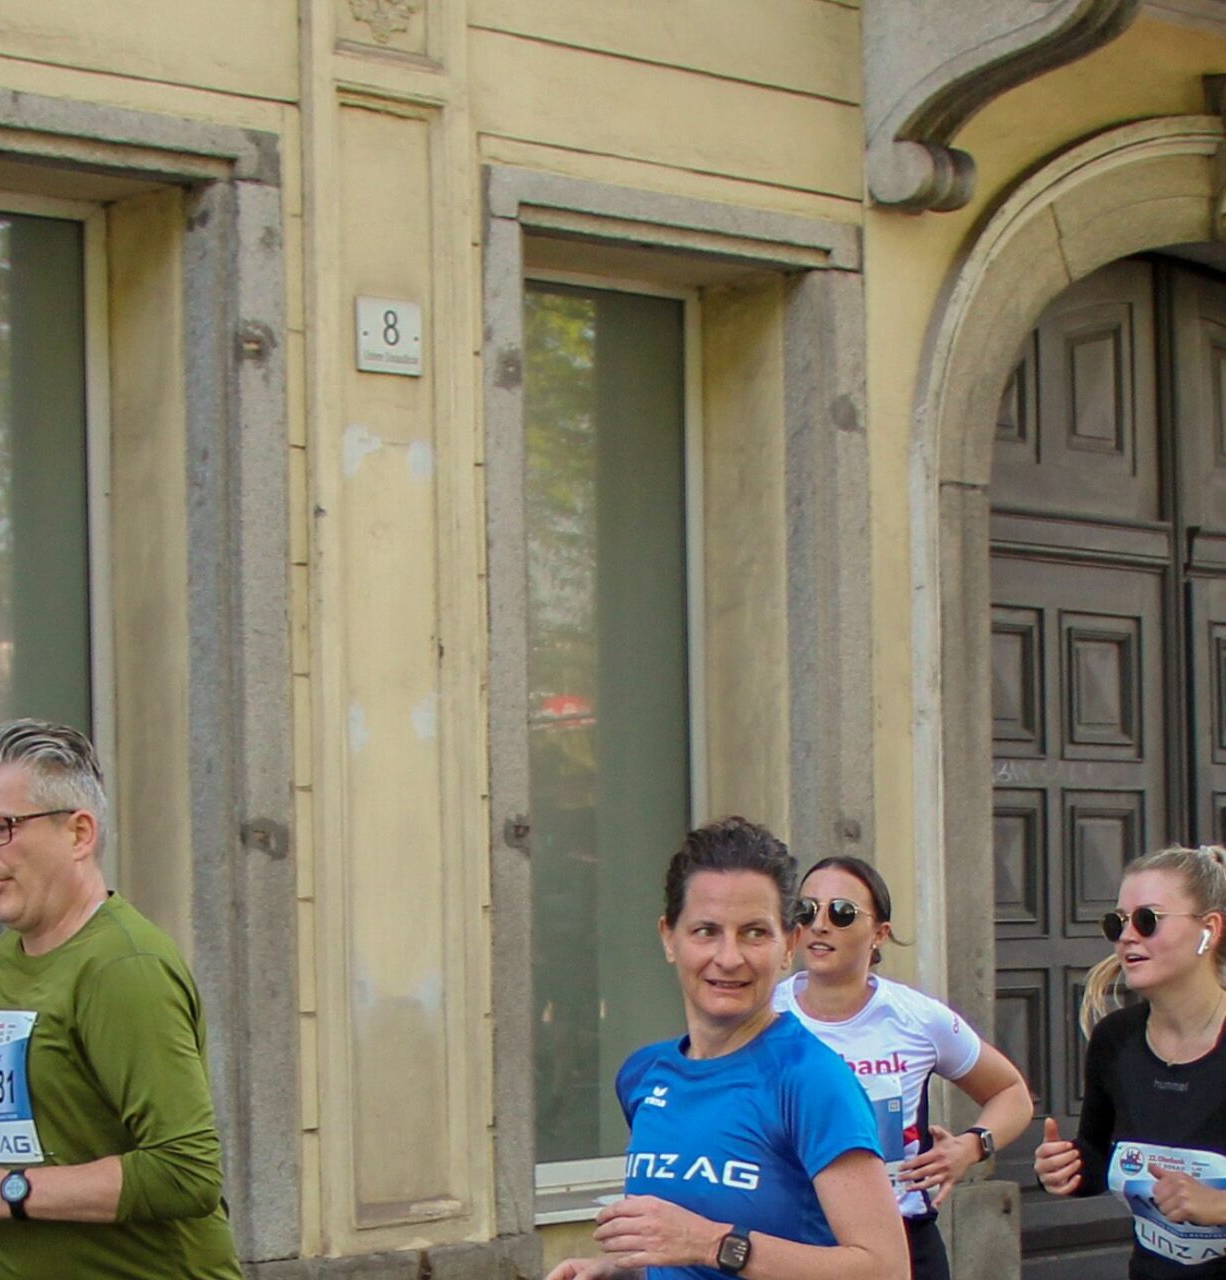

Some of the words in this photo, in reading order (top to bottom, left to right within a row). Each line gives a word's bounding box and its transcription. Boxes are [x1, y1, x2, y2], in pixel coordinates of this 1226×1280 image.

[383, 310, 399, 346] 8
[839, 1052, 909, 1075] bank
[0, 1135, 31, 1153] AG
[626, 1153, 679, 1179] INZ
[683, 1156, 761, 1190] AG
[1141, 1223, 1192, 1259] LINZ
[1201, 1247, 1226, 1260] A
